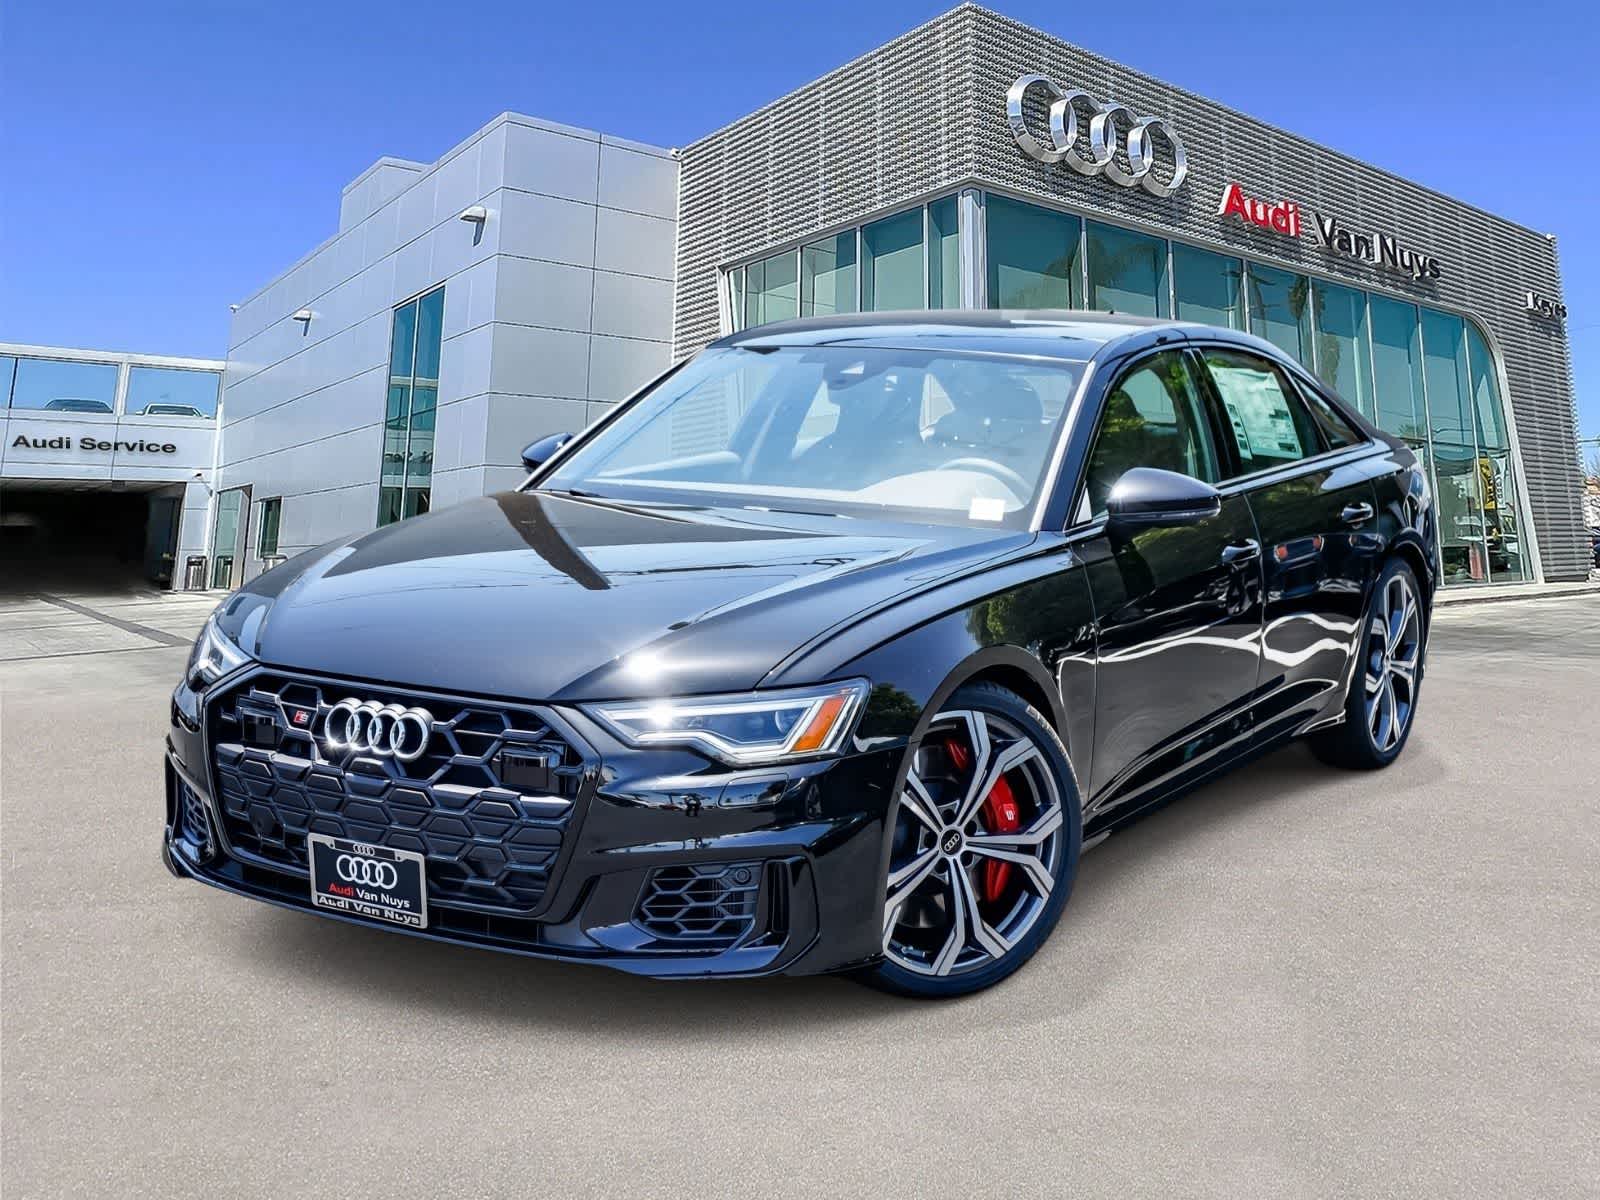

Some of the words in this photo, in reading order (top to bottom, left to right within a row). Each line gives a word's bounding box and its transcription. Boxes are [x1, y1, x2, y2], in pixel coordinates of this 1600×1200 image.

[1217, 183, 1302, 237] Audi
[1311, 212, 1371, 260] Van
[1372, 233, 1442, 281] Nuys
[1526, 291, 1568, 319] Keyes
[12, 434, 71, 449] Audi
[79, 437, 178, 454] Service
[328, 882, 354, 897] Audi
[356, 887, 378, 901] Van
[380, 893, 410, 909] Nuys
[318, 895, 349, 909] Audi
[353, 903, 380, 916] Van
[384, 911, 420, 925] Nuys
